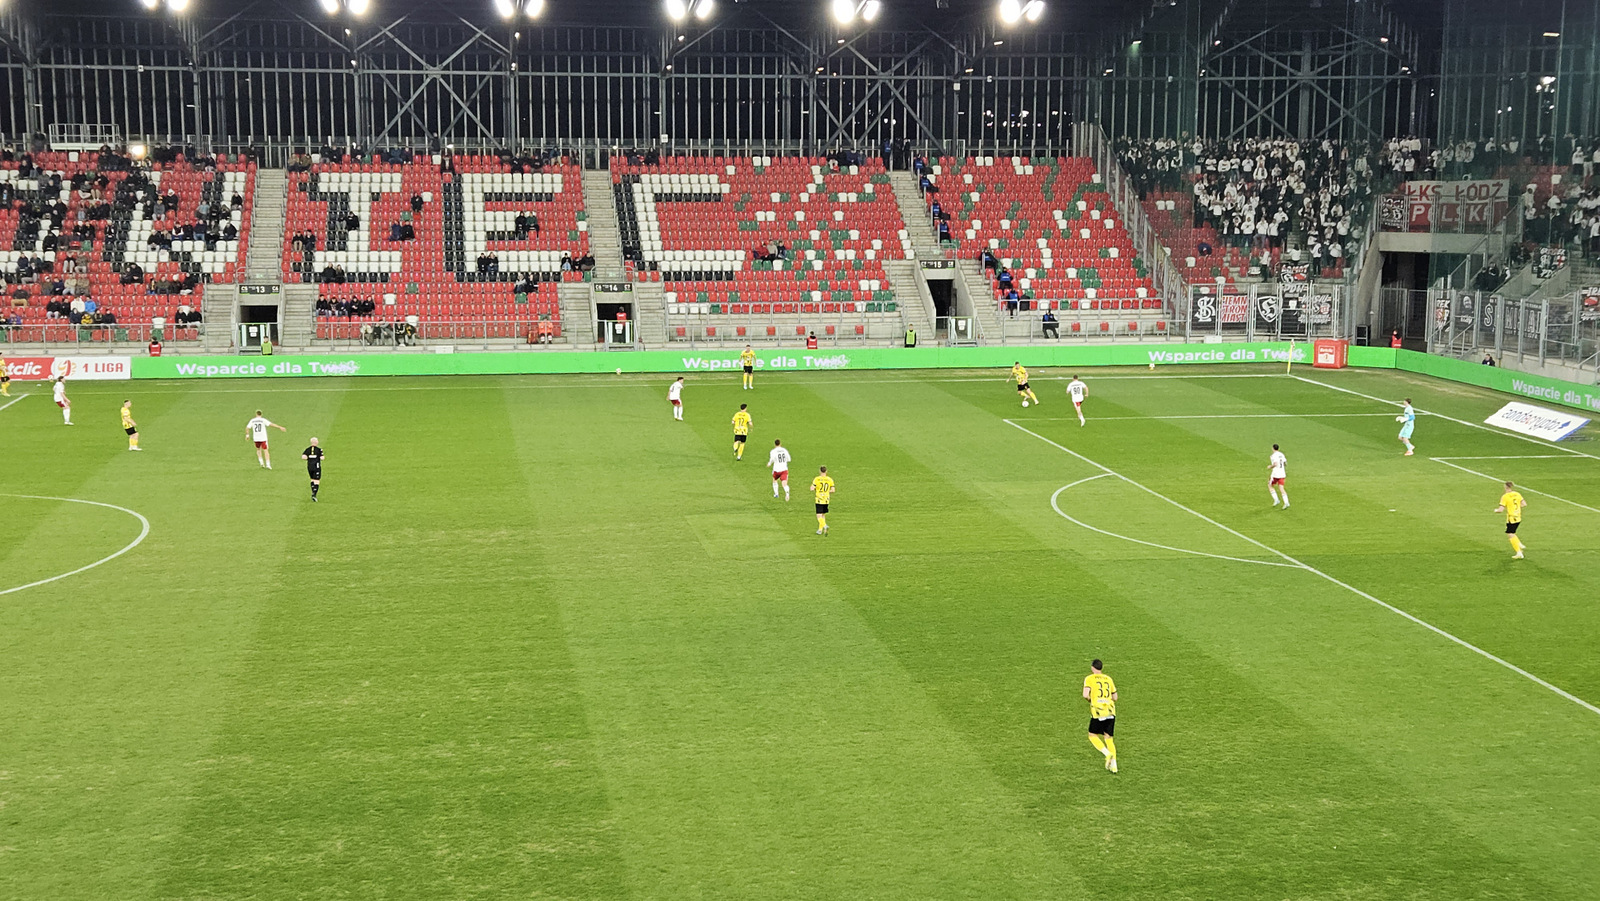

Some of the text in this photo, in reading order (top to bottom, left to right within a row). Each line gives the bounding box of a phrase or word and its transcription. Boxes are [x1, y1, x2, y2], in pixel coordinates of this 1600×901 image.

[1407, 184, 1442, 201] ŁKS
[255, 285, 265, 293] 13
[609, 284, 618, 292] 14
[1148, 350, 1225, 363] Wsparcie
[1231, 349, 1255, 360] dla
[83, 363, 123, 373] 1 LIGA
[175, 362, 267, 376] Wsparcie
[273, 361, 302, 374] dla
[682, 356, 765, 371] Wspare
[770, 356, 797, 368] dla
[1512, 379, 1560, 400] Wsparcie
[1564, 391, 1581, 404] dla
[254, 423, 262, 432] 20
[819, 483, 829, 493] 20
[1096, 681, 1110, 698] 33
